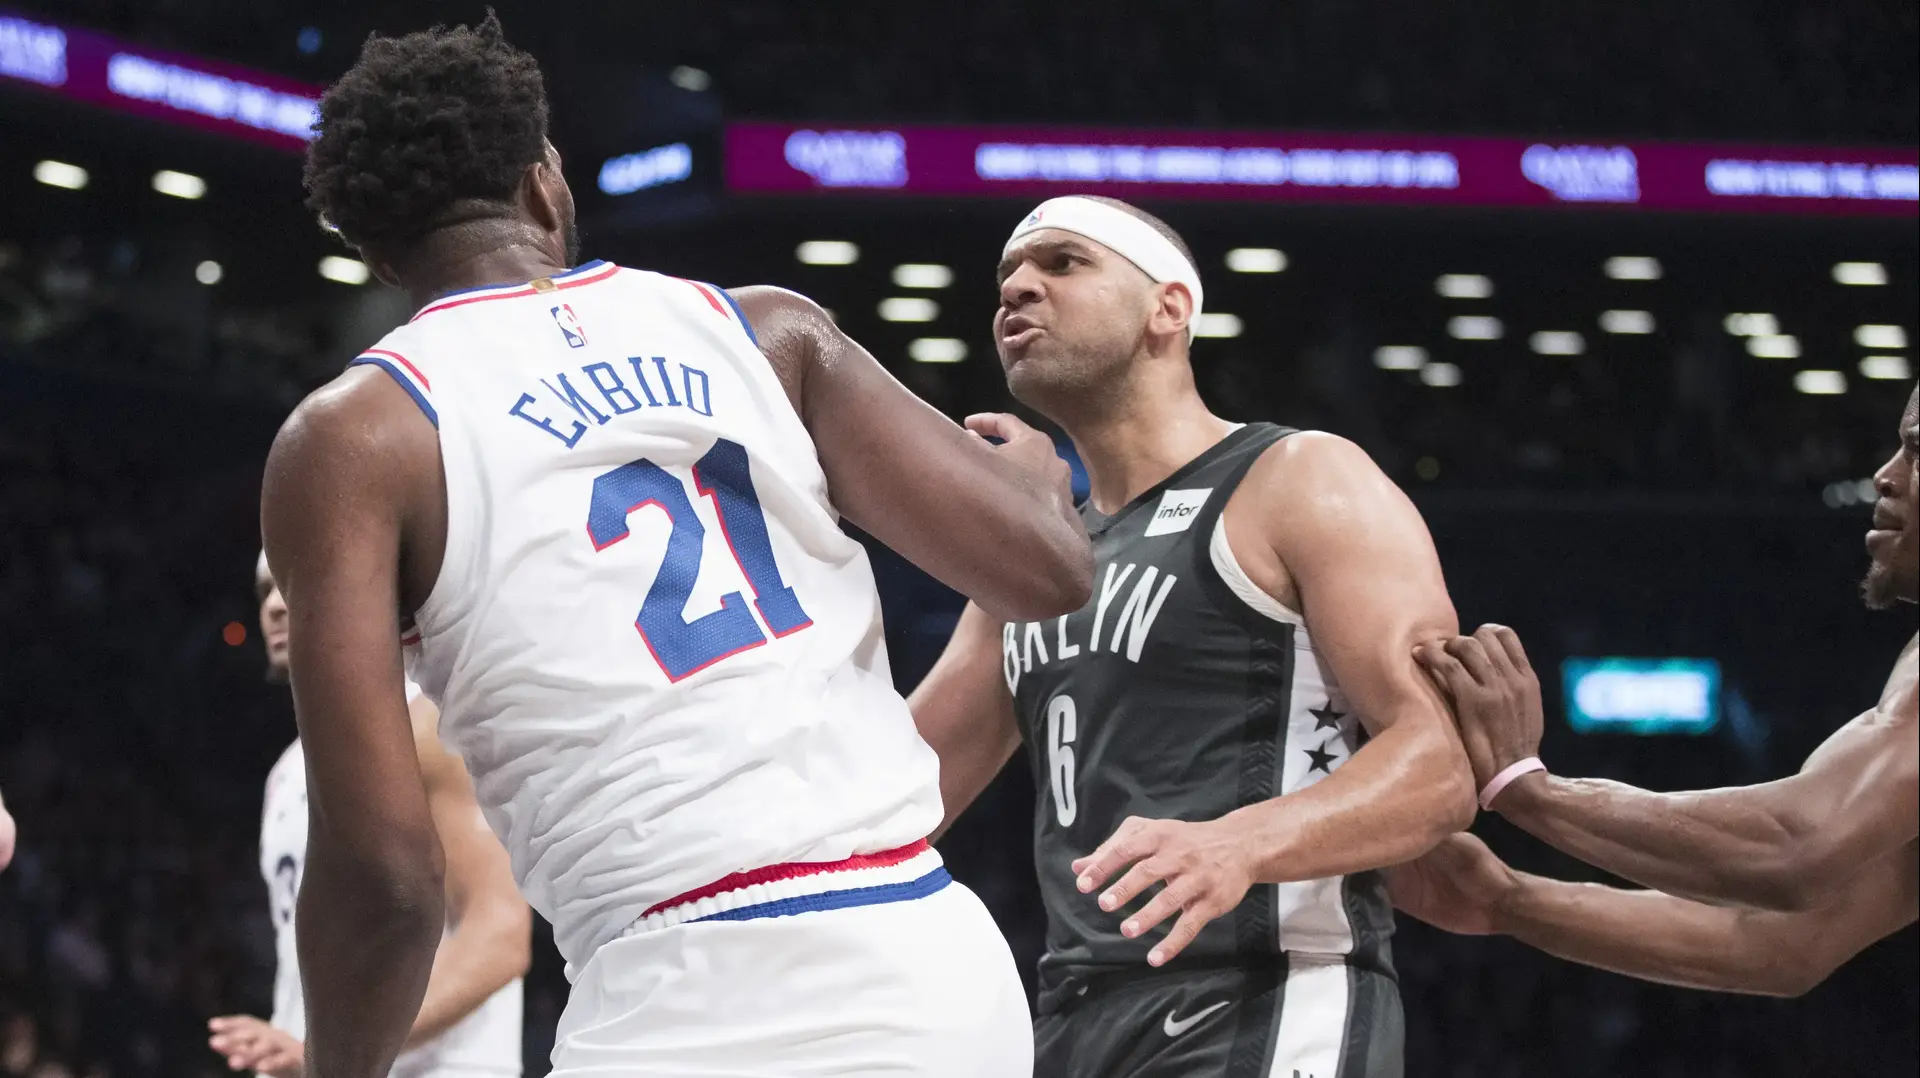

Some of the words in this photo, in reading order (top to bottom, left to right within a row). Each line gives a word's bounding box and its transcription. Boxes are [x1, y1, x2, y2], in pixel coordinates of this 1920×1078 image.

[586, 437, 814, 684] 21
[1157, 502, 1199, 519] infor
[1048, 695, 1077, 827] 6
